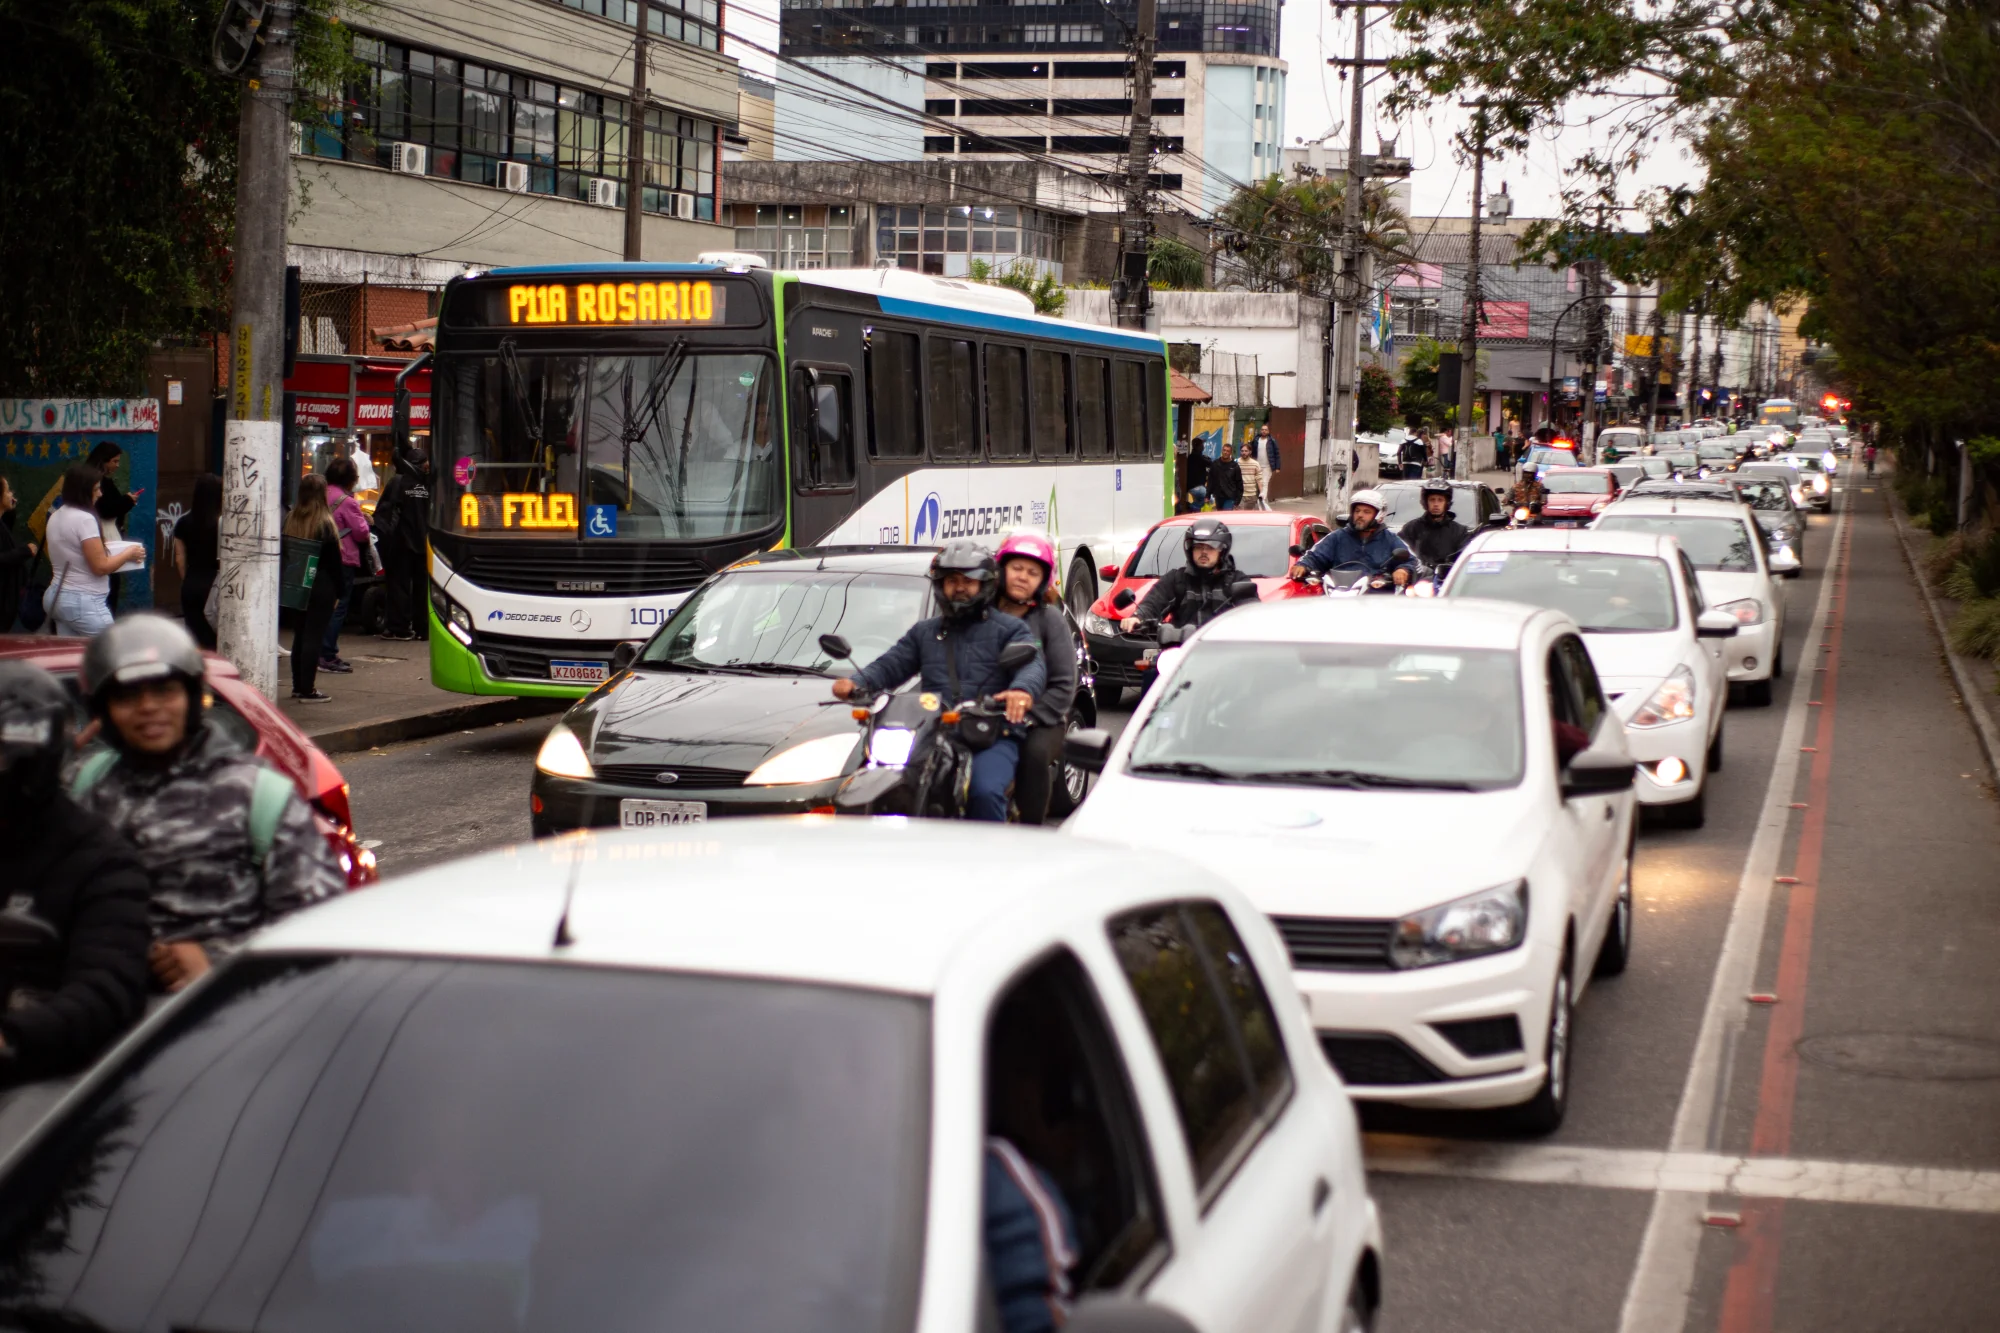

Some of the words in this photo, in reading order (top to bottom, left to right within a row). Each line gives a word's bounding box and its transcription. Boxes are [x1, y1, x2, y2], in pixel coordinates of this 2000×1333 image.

[510, 285, 567, 322] P11A
[577, 282, 713, 321] ROSARIO
[41, 403, 58, 428] O
[62, 401, 128, 430] MELHOR
[308, 403, 340, 414] CHURROS
[358, 404, 379, 418] PIPOCA
[379, 405, 388, 418] DO
[461, 493, 479, 527] A
[941, 509, 975, 539] DEDO
[976, 507, 992, 536] DE
[879, 526, 900, 545] 1018
[505, 613, 528, 621] DEDO
[527, 614, 540, 622] DE
[539, 615, 562, 623] DEUS
